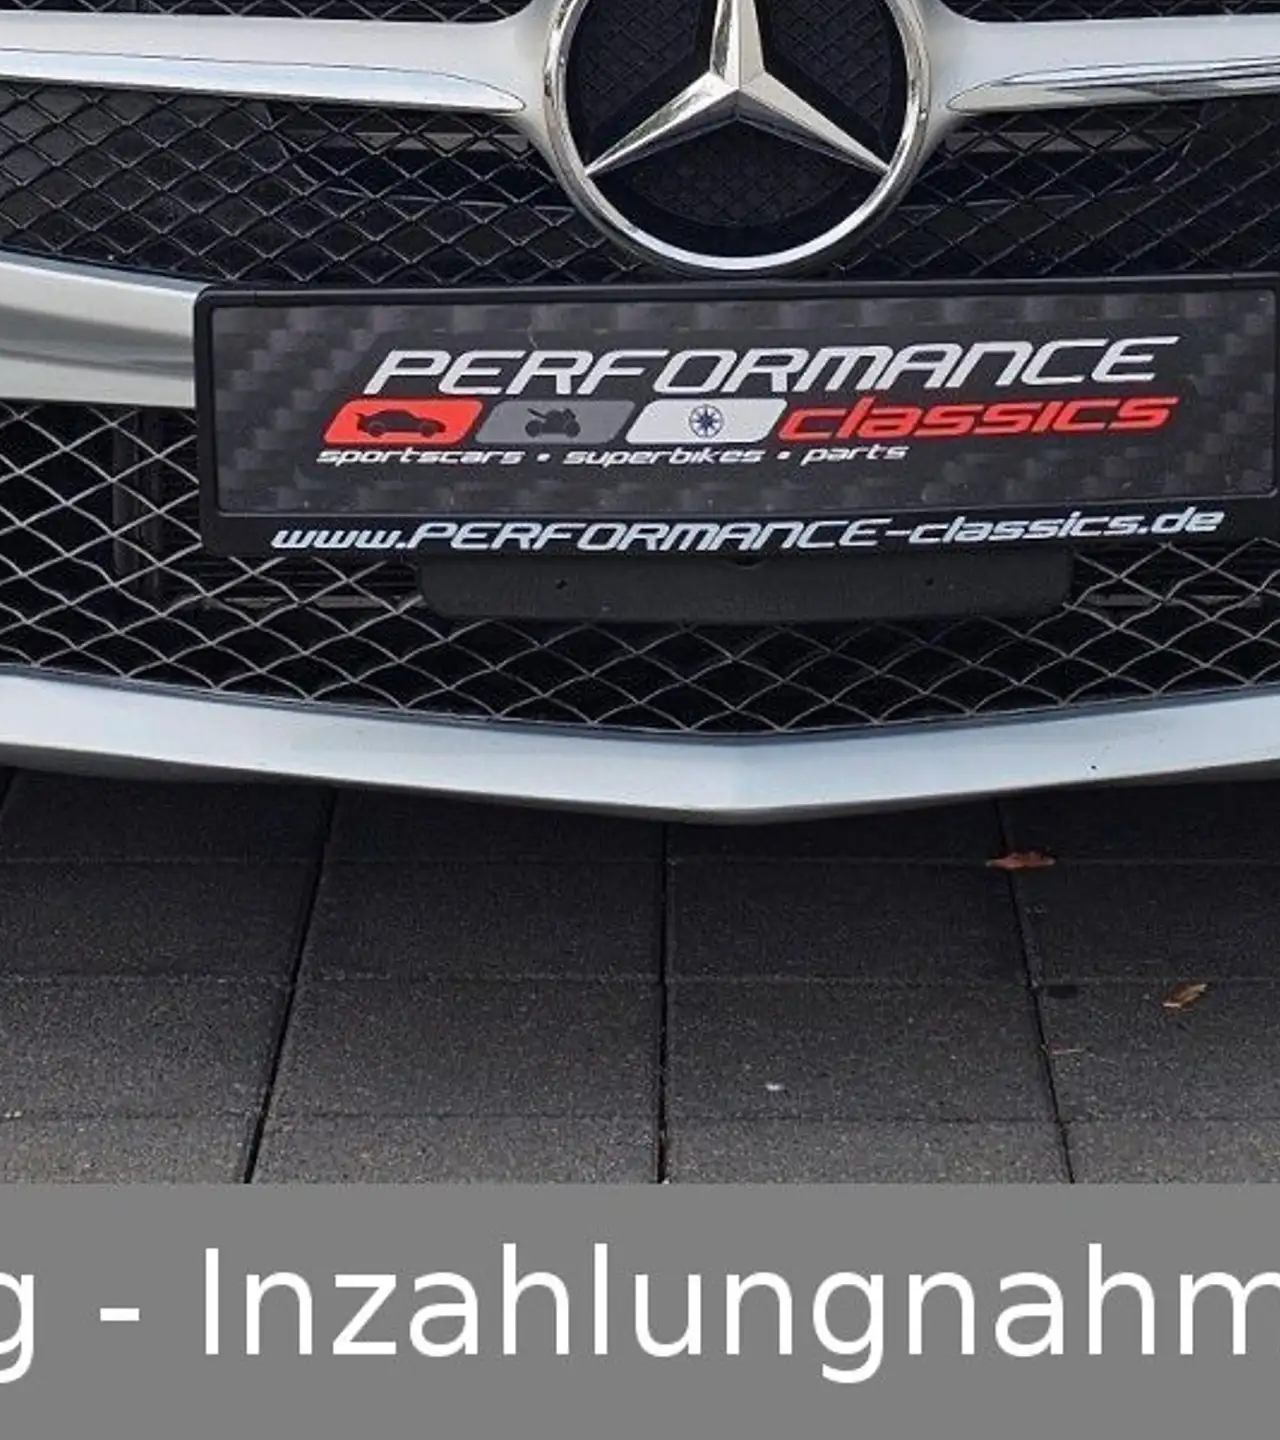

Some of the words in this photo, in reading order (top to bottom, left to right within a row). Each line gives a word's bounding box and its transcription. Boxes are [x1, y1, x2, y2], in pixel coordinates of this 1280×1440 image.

[362, 336, 1181, 396] PERFORMANCE
[777, 394, 1180, 442] classics
[315, 446, 524, 468] sportscars
[562, 446, 767, 468] superbikes
[800, 443, 911, 466] parts
[270, 505, 1226, 553] www.PERFORMANCE-classics.de
